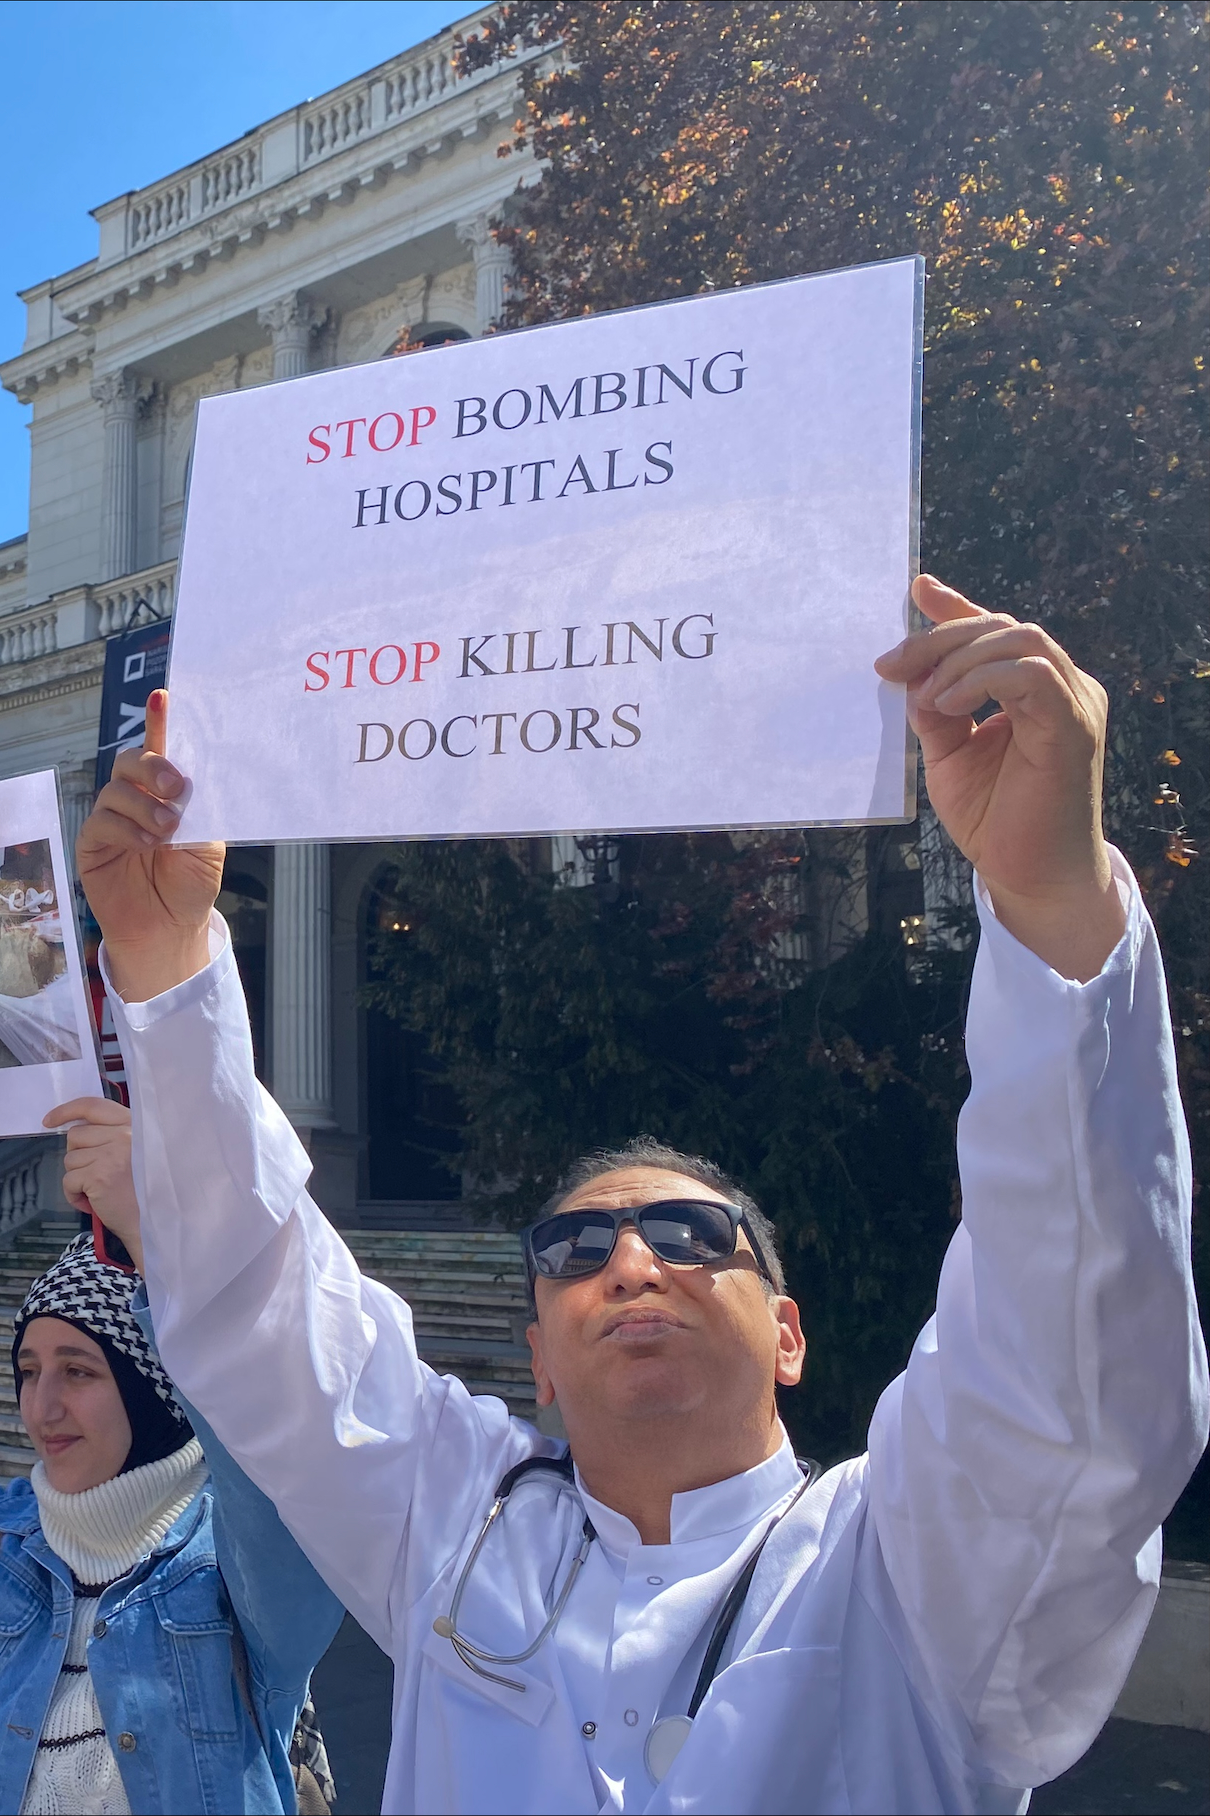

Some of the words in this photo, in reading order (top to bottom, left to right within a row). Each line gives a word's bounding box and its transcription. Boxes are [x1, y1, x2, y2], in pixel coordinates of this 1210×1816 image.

[306, 405, 436, 464] STOP
[451, 349, 749, 439] BOMBING
[352, 440, 674, 528] HOSPITALS
[304, 641, 441, 693] STOP
[455, 613, 718, 679] KILLING
[353, 703, 642, 763] DOCTORS
